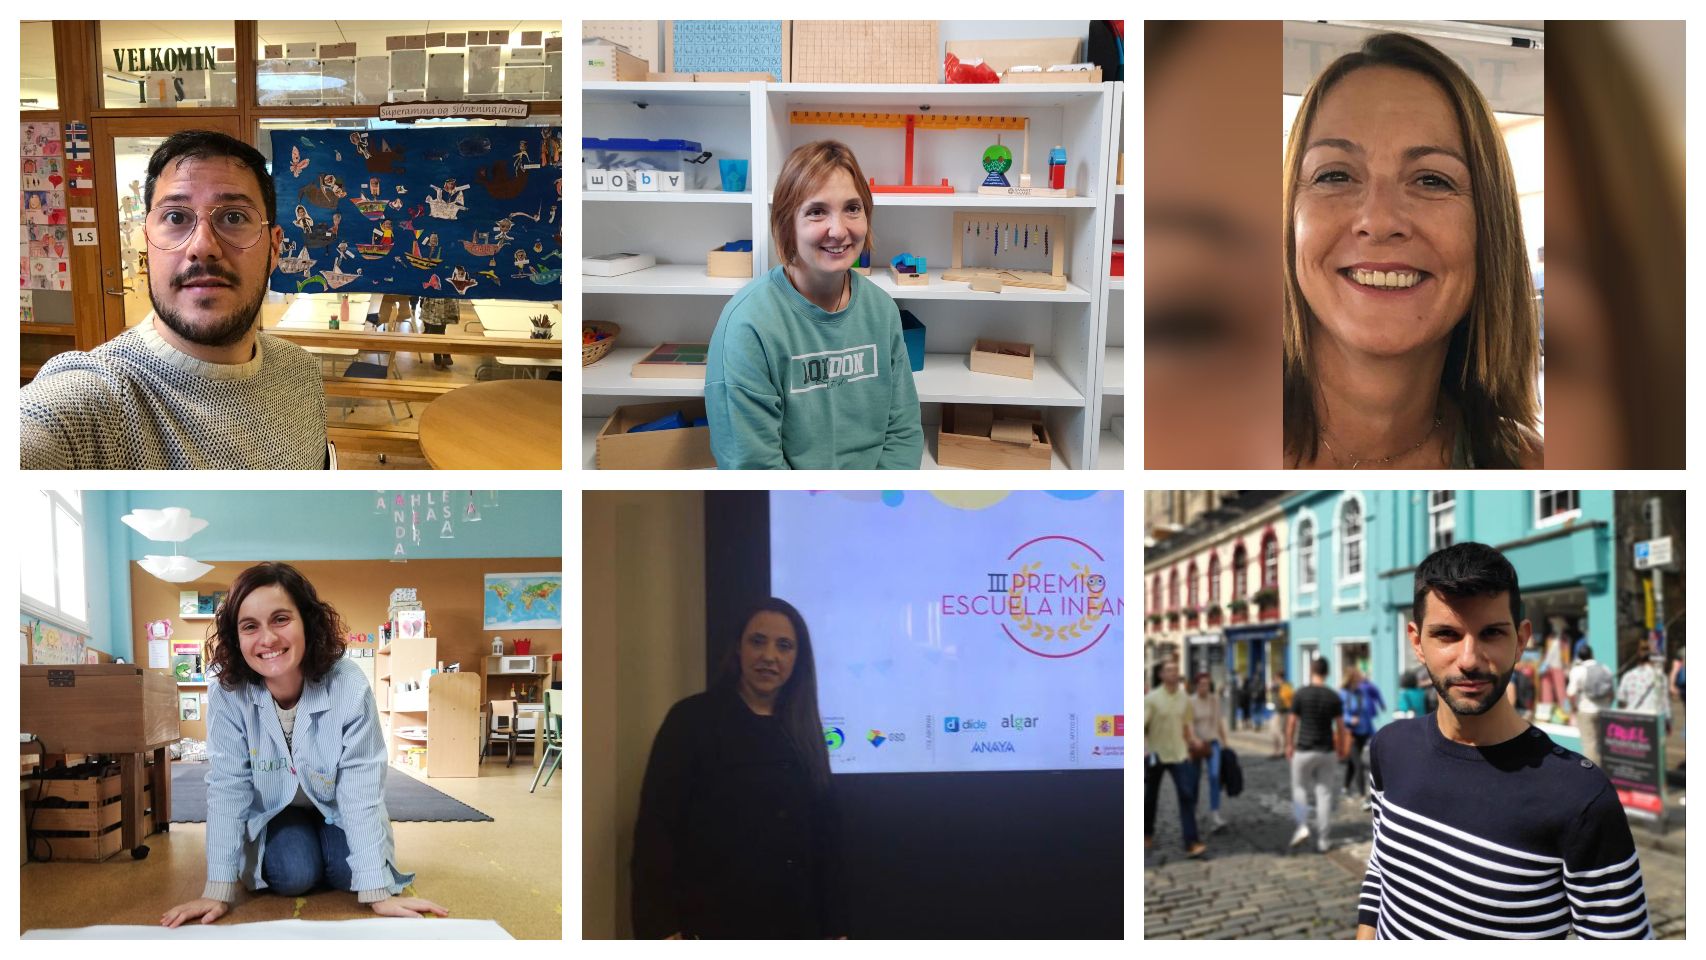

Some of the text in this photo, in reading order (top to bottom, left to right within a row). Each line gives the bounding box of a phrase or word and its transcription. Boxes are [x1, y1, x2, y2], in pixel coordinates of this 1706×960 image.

[112, 46, 216, 72] VELKOMIN
[174, 77, 185, 102] S
[438, 106, 448, 116] og
[78, 232, 93, 242] 1.S
[988, 573, 1106, 594] III PREMIO
[942, 595, 1052, 616] ESCUELA
[1000, 713, 1039, 730] algar
[971, 740, 1015, 753] ANAYA
